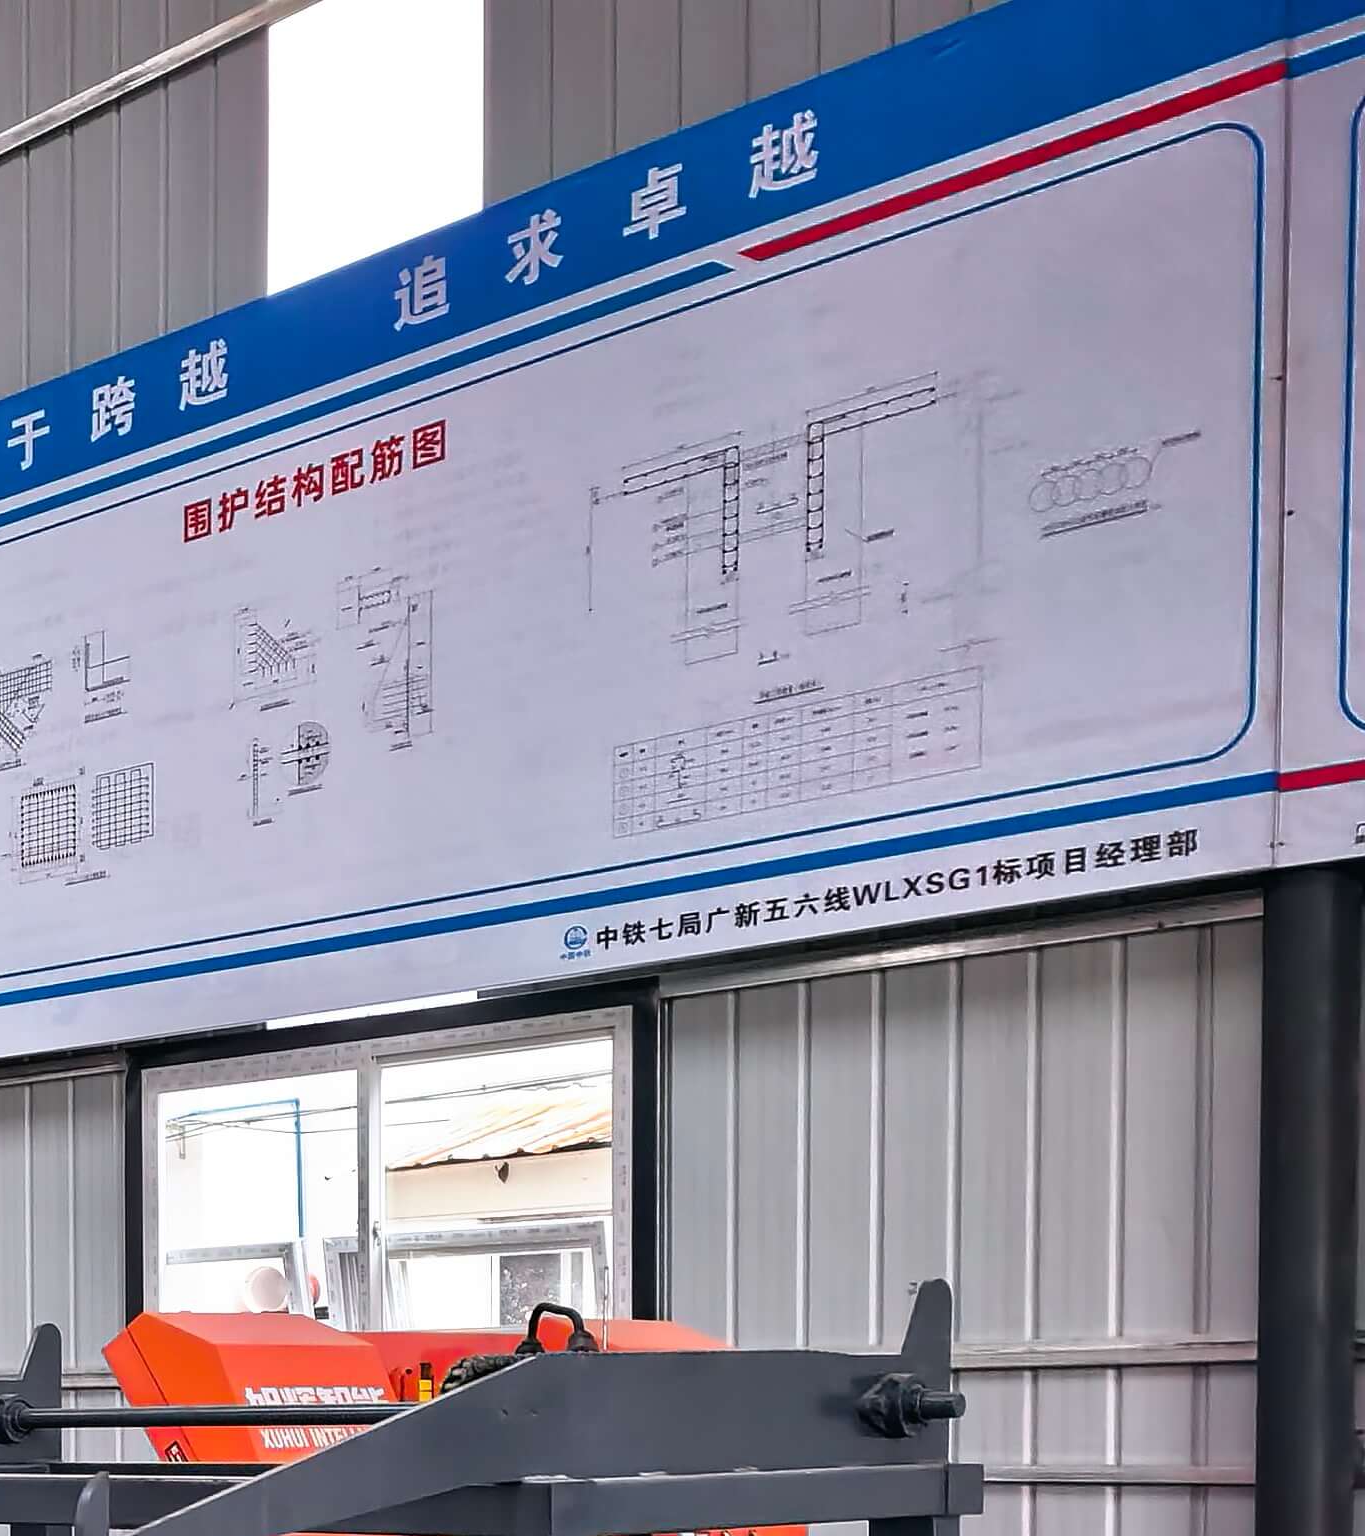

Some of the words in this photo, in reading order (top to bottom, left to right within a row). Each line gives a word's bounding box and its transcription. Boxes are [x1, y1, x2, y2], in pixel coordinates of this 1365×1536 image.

[393, 109, 819, 331] 追求卓越
[183, 419, 447, 543] 围护结构配筋图
[595, 828, 1200, 951] 中铁七局广新五六线WLXSG1标项目经理部
[260, 1427, 310, 1450] XUHUI
